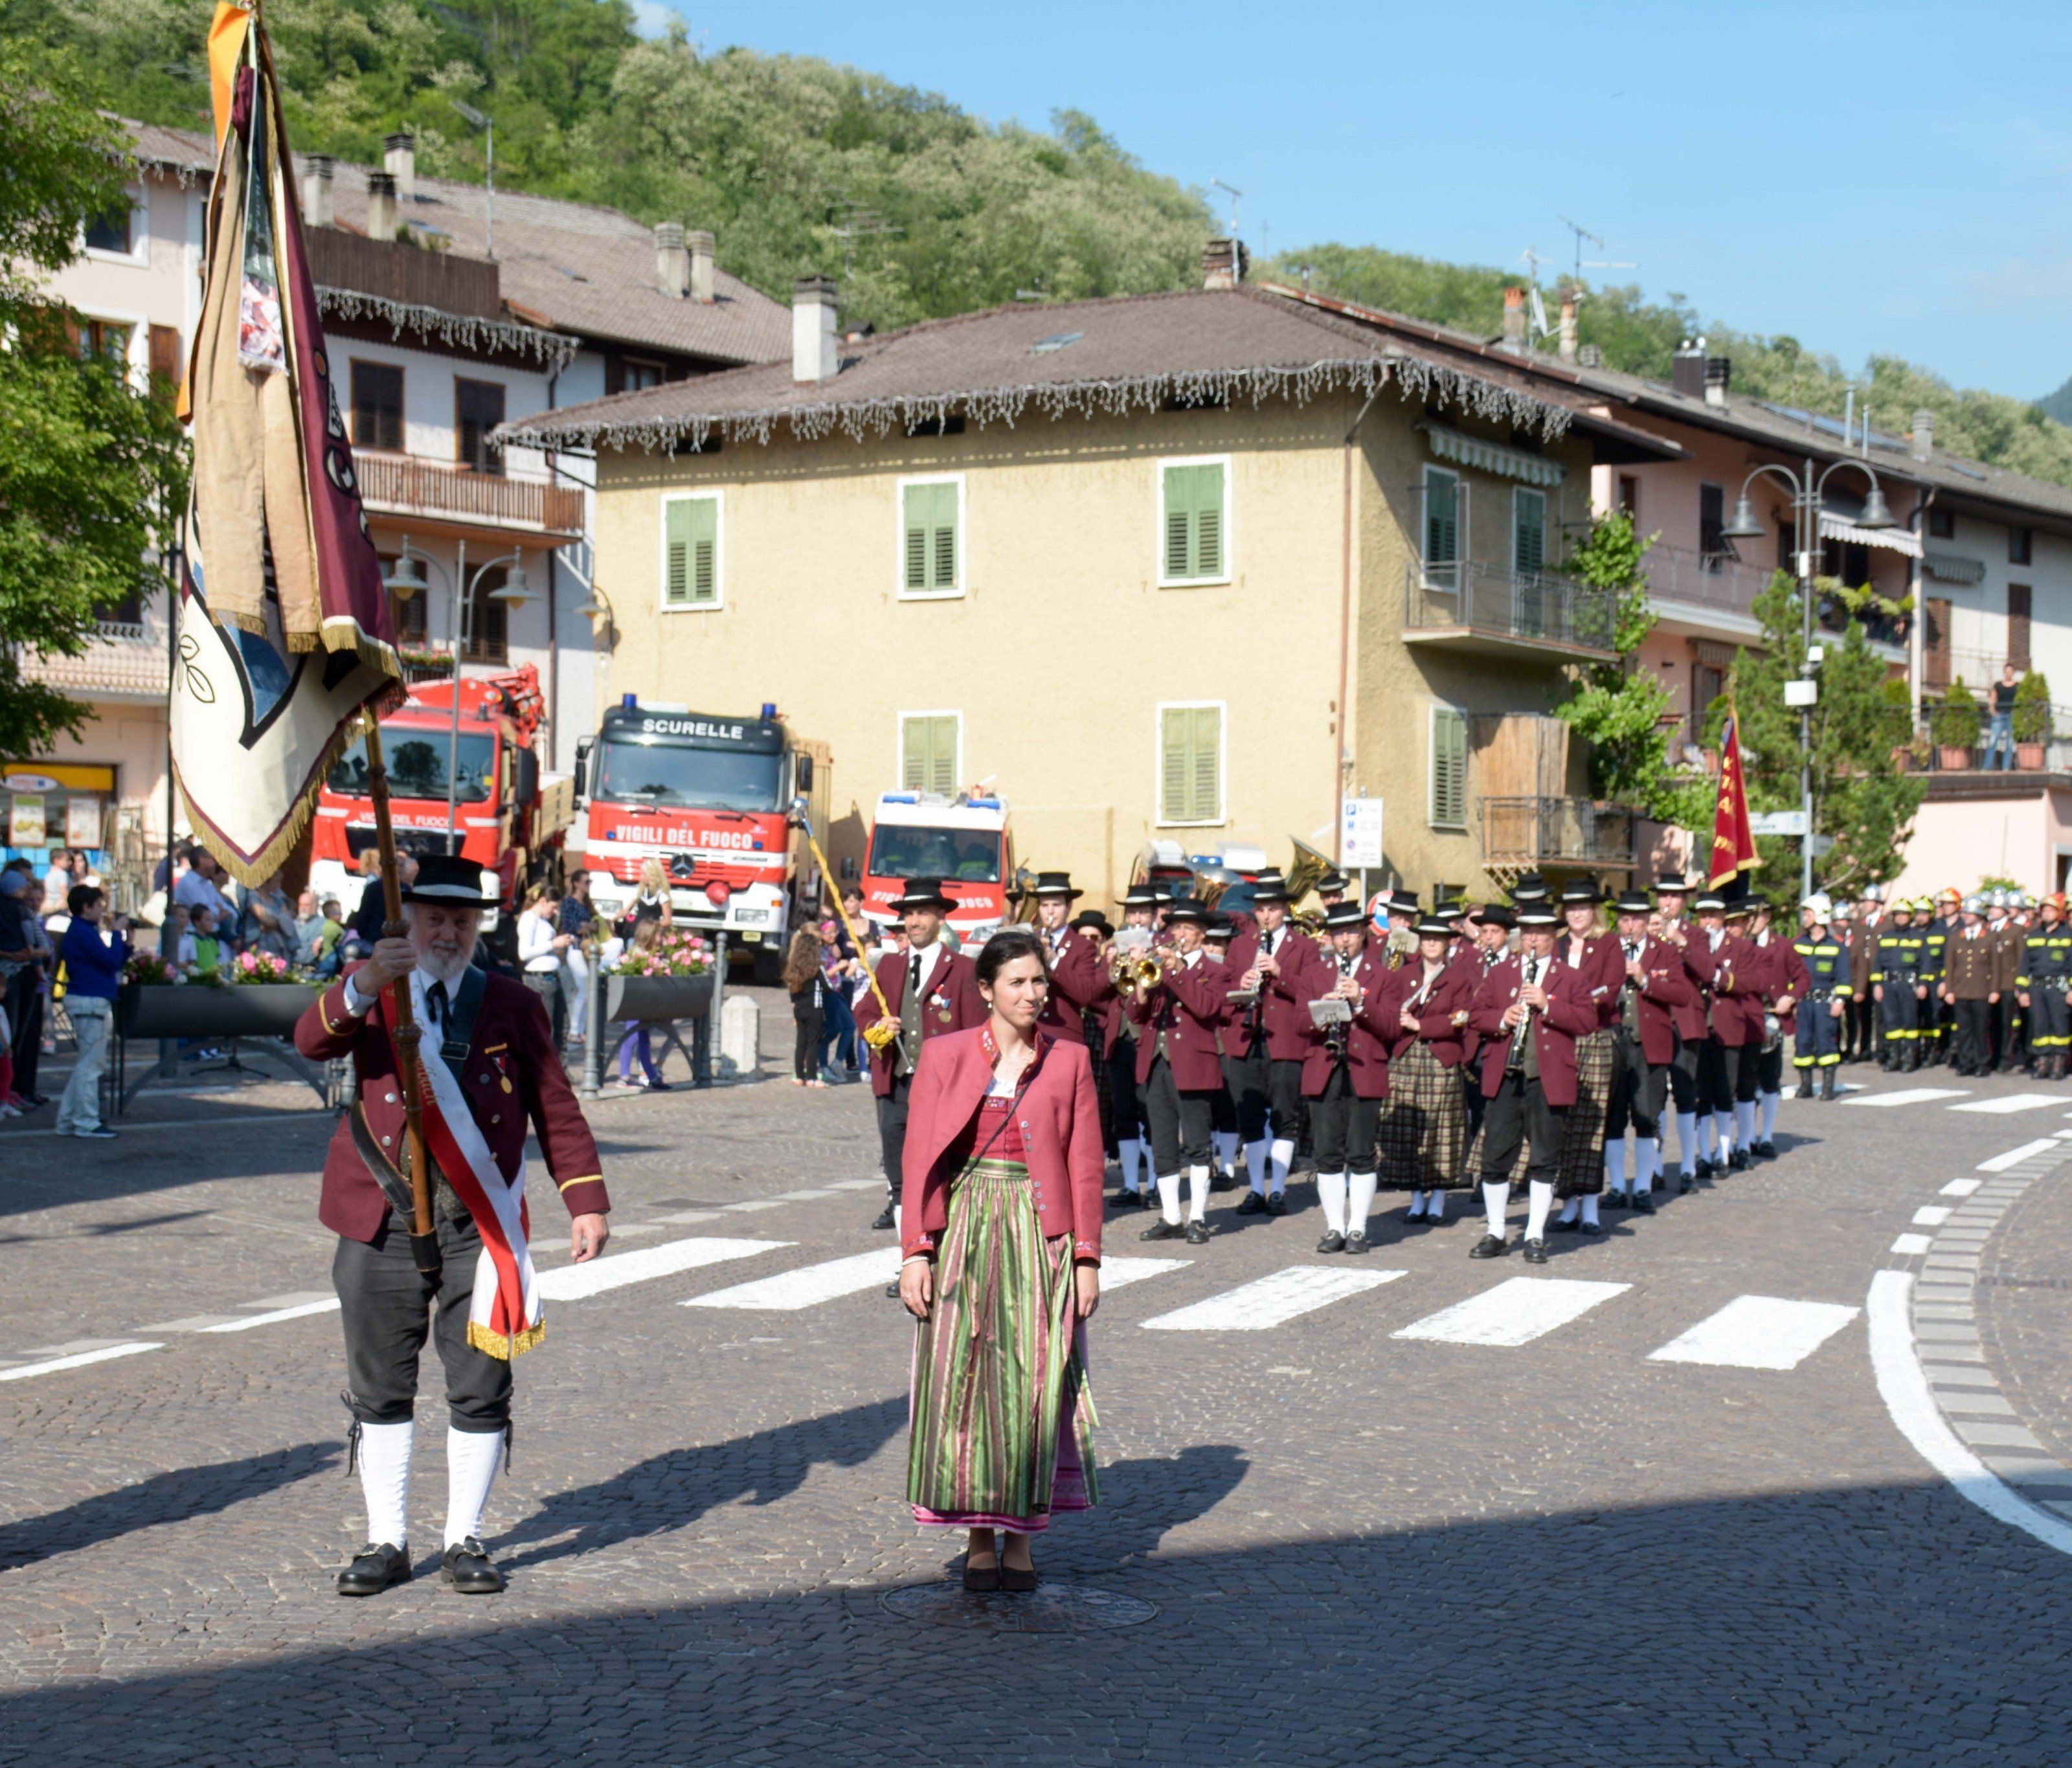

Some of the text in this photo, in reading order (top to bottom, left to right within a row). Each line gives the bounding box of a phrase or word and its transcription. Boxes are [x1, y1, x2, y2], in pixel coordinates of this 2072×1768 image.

[642, 718, 743, 740] SCURELLE
[616, 825, 752, 849] VIGILI DEL FUOCO
